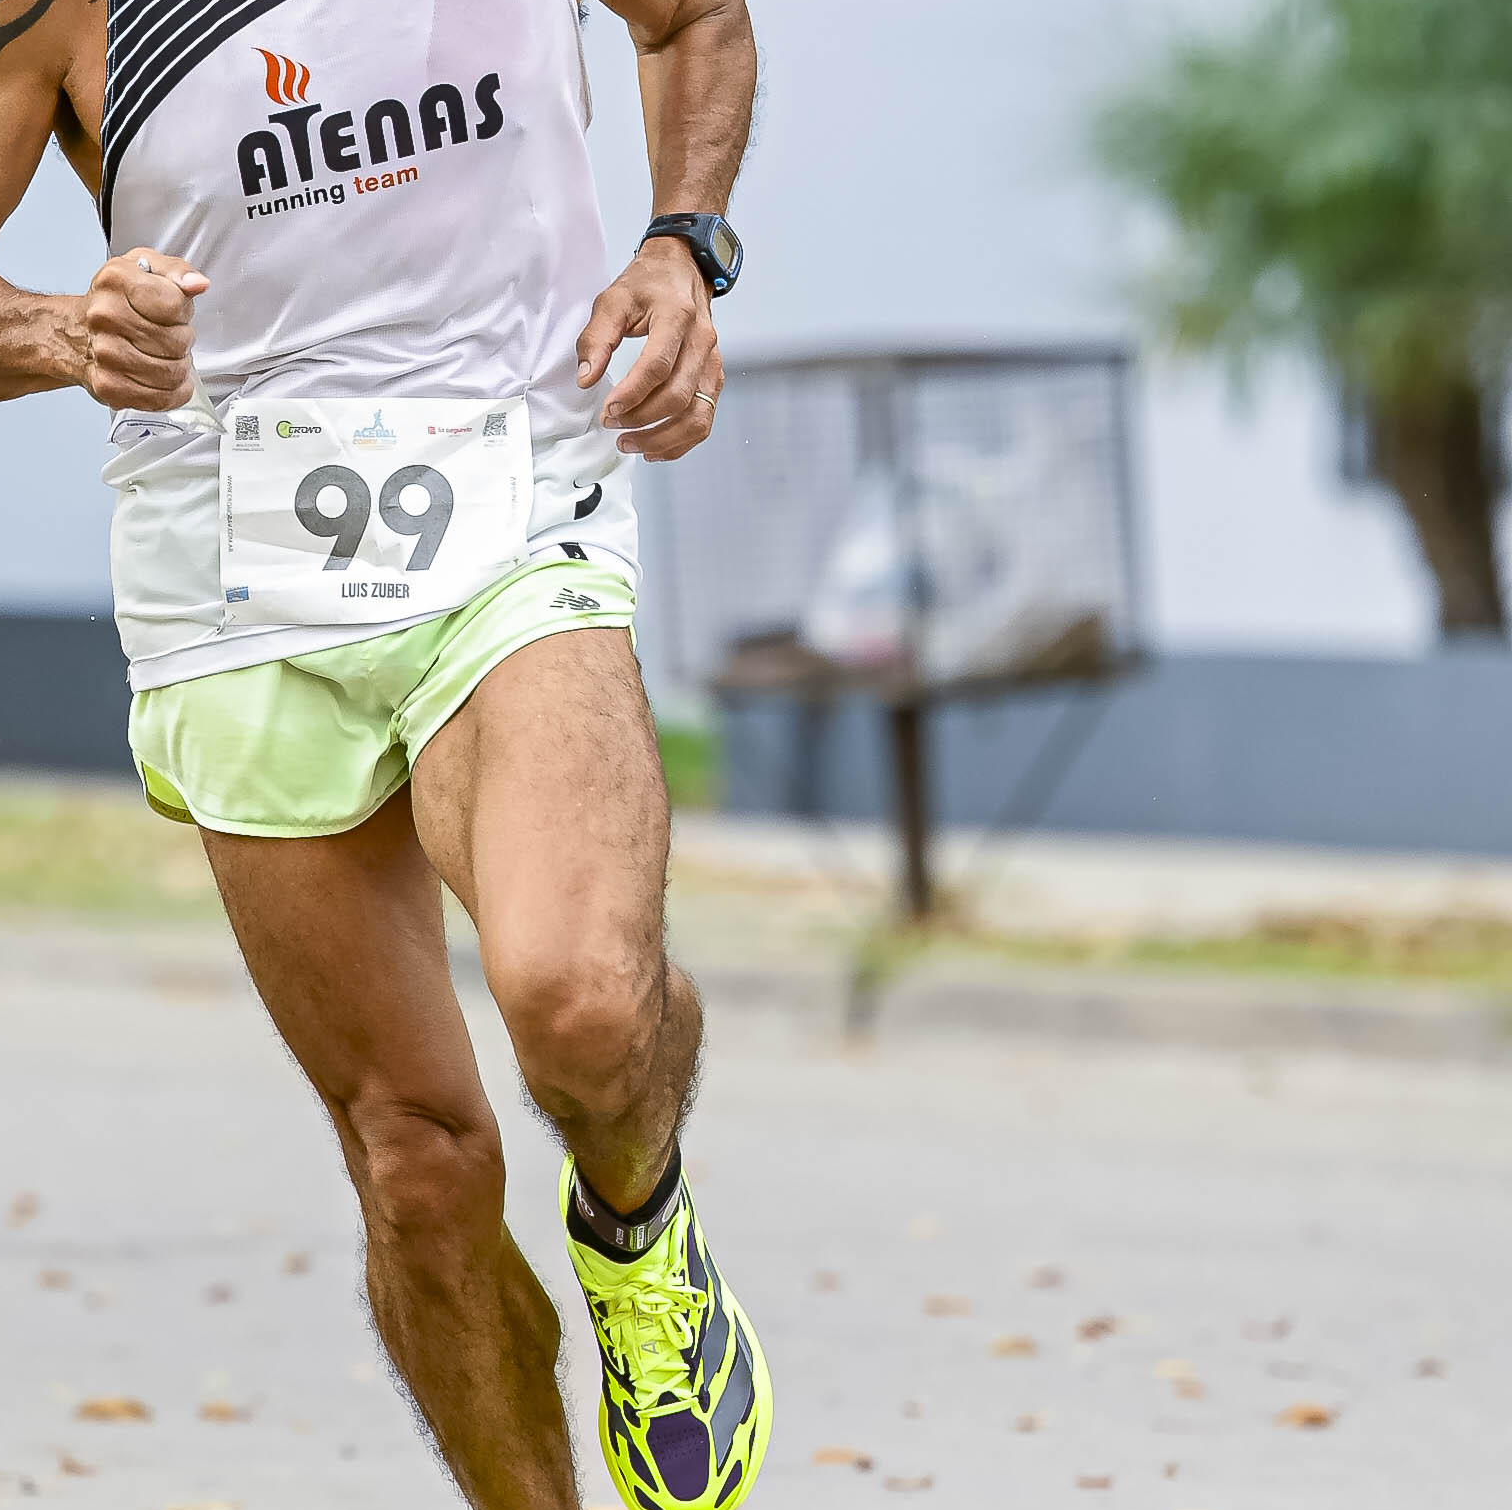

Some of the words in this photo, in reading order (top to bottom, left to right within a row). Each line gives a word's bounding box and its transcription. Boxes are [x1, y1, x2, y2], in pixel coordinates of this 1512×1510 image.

[236, 72, 505, 197] ATENAS
[246, 182, 346, 220] running
[353, 166, 419, 195] team
[295, 464, 454, 572] 99
[341, 582, 368, 598] LUIS
[371, 582, 410, 599] ZUBER
